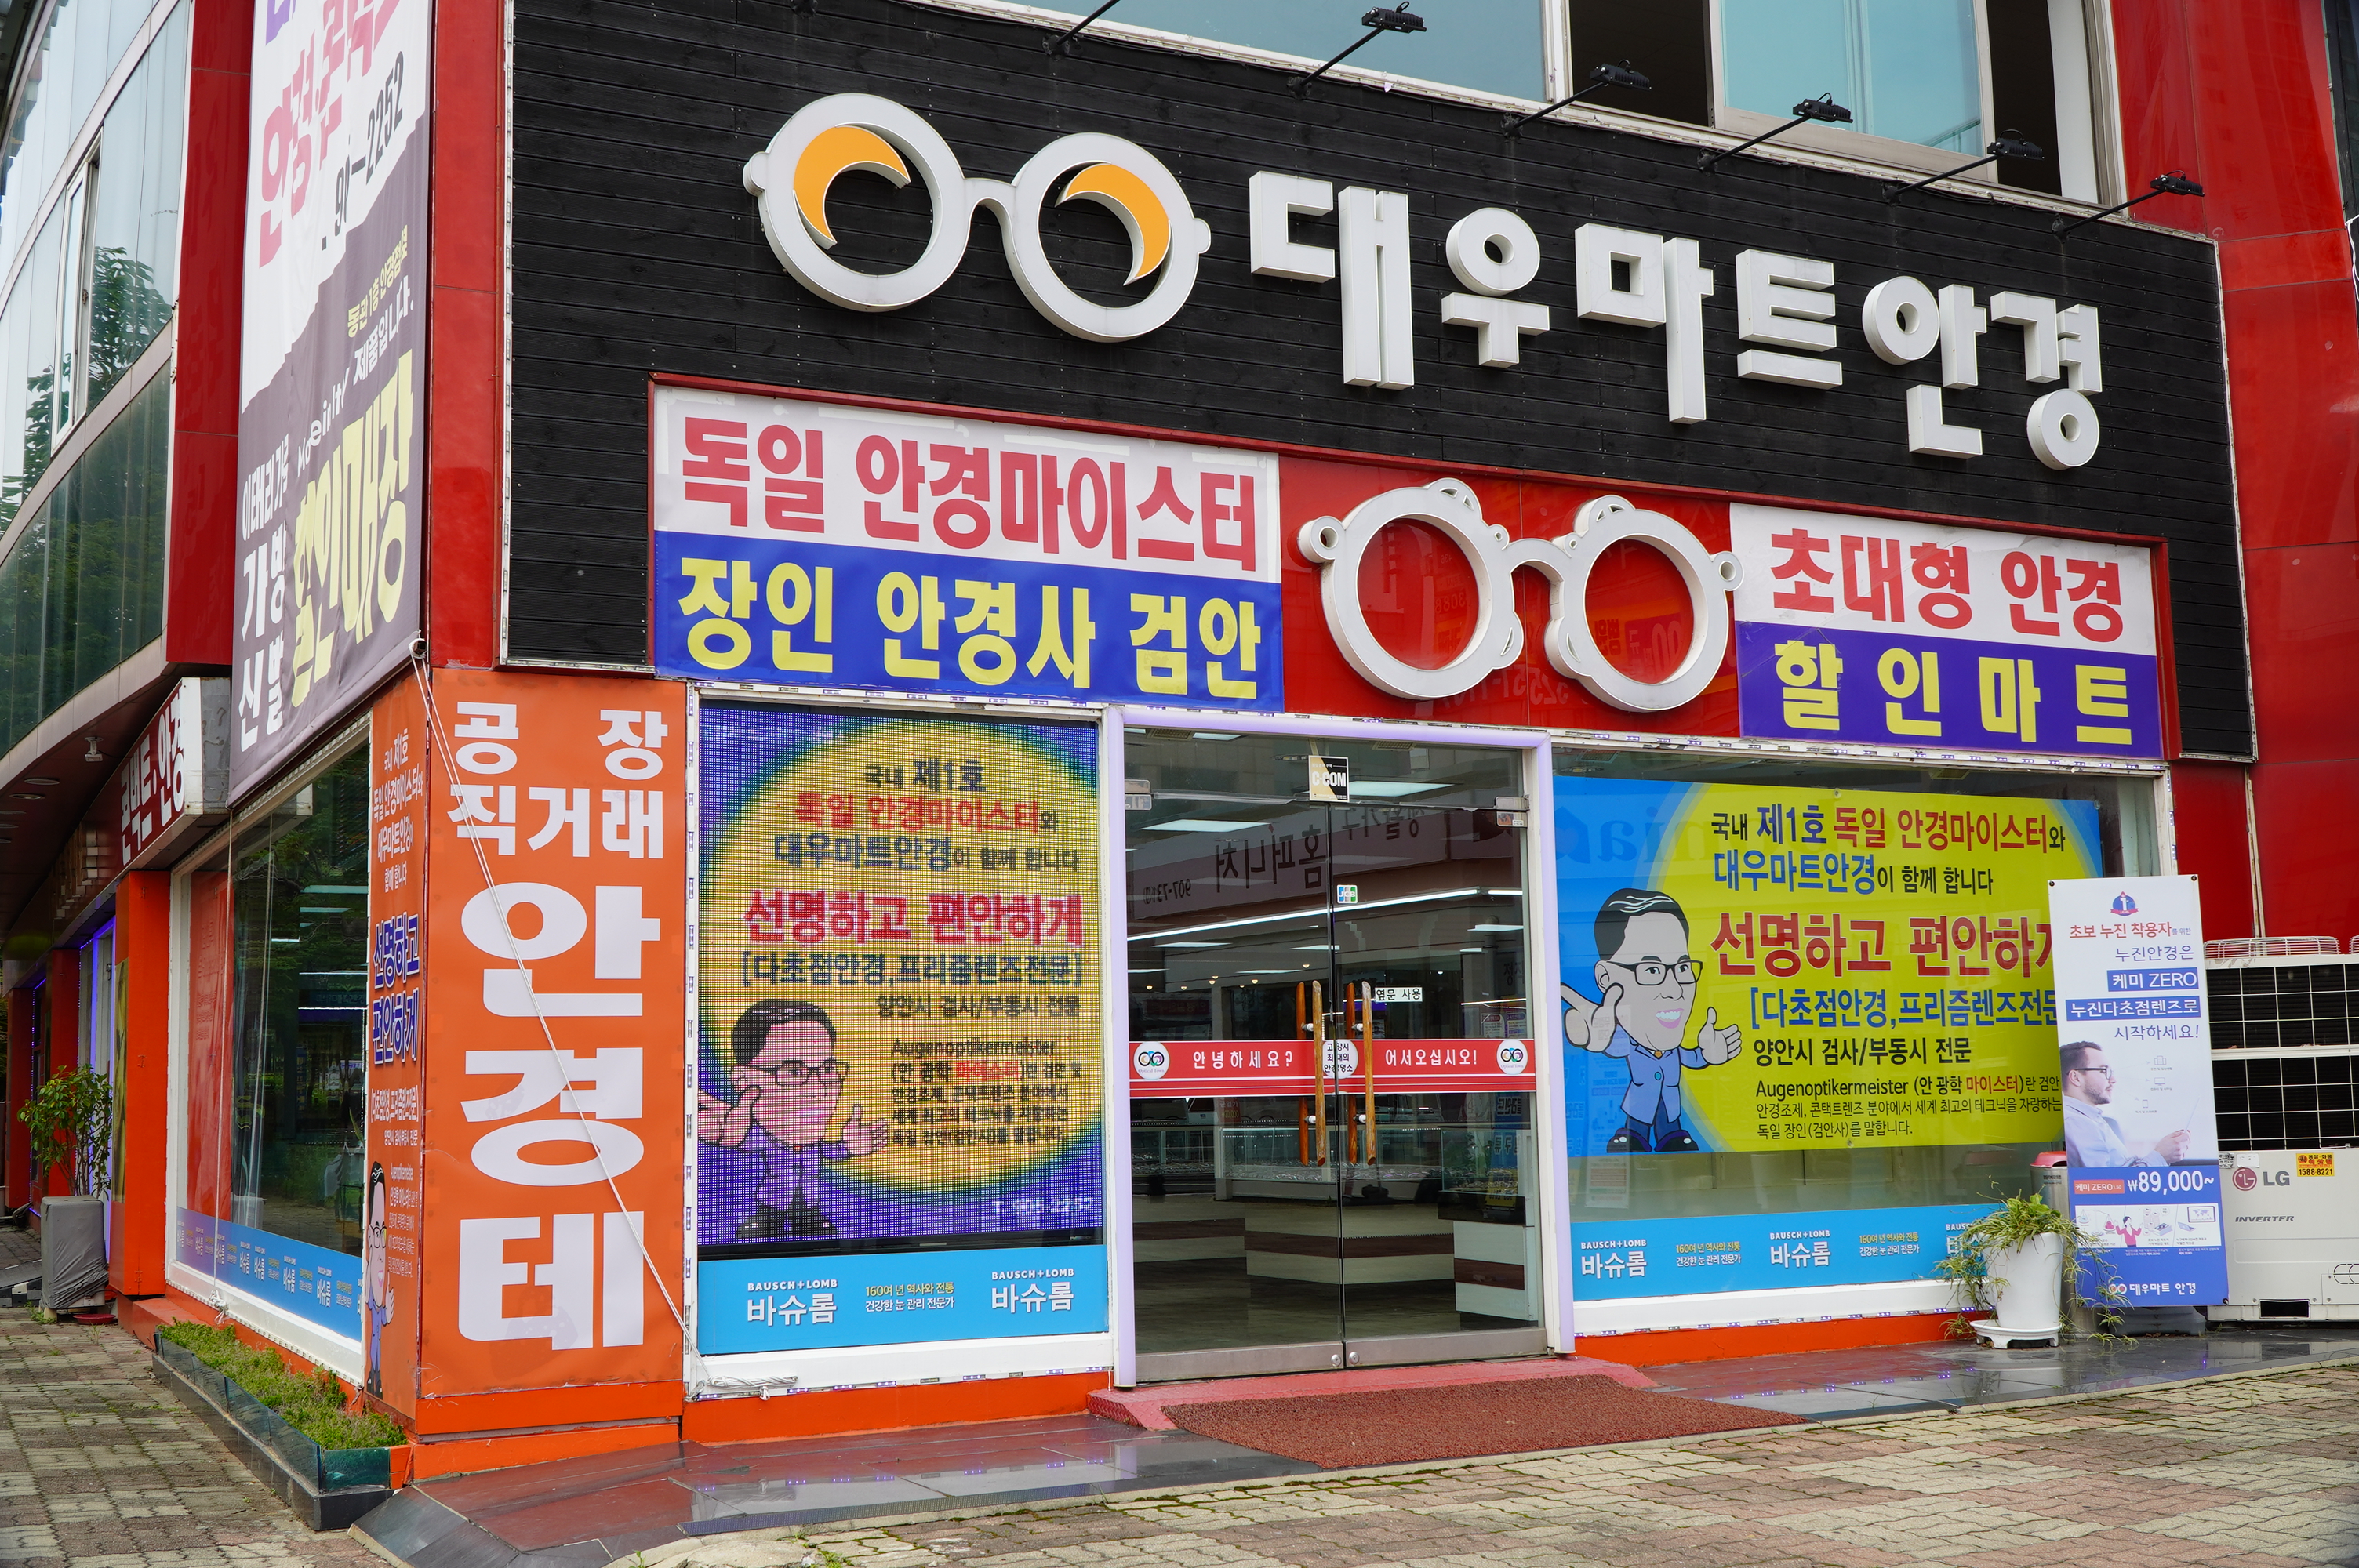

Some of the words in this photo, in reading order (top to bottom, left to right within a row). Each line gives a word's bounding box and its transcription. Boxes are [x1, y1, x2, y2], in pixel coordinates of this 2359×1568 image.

[1249, 170, 2103, 470] 대우마트안경
[682, 416, 824, 533] 독일
[856, 434, 1256, 572] 안경마이스터
[242, 521, 286, 641] 가방
[1769, 528, 1973, 630] 초대형
[2001, 550, 2125, 644] 안경
[678, 557, 834, 673] 장인
[876, 570, 1096, 688] 안경사
[1129, 593, 1261, 700] 검안
[239, 630, 284, 752] 신발
[1775, 638, 2132, 747] 할인마트
[864, 764, 903, 789] 국내
[912, 758, 987, 792] 제1호
[1312, 771, 1347, 787] C-COM
[447, 783, 664, 859] 직거래
[795, 793, 853, 829] 독일
[868, 793, 1059, 833] 안경마이스터와
[1711, 812, 1748, 841] 국내
[1757, 804, 1827, 844] 제1호
[1834, 807, 1886, 848] 독일
[1898, 809, 2065, 853] 안경마이스터와
[774, 833, 970, 872] 대우마트안경이
[980, 847, 1016, 871] 함께
[1025, 848, 1079, 872] 합니다
[1714, 849, 1893, 895] 대우마트안경이
[1901, 866, 1937, 894] 함께
[1943, 866, 1994, 895] 합니다
[743, 890, 911, 946] 선명하고
[927, 893, 1084, 946] 편안하게
[2070, 925, 2096, 938] 초보
[2100, 923, 2127, 939] 누진
[373, 912, 420, 989] 선명하고
[1710, 912, 1892, 978] 선명하고
[2115, 945, 2194, 962] 누진안경은
[2113, 973, 2143, 989] 케미
[2149, 972, 2197, 987] ZERO
[877, 995, 931, 1018] 양안시
[1048, 993, 1081, 1018] 전문
[1402, 988, 1420, 1000] 사용
[2071, 1000, 2199, 1018] 누진다초점렌즈로
[373, 988, 419, 1065] 편안하게
[2114, 1025, 2199, 1041] 시작하세요!
[1193, 1048, 1293, 1069] 안녕하세요?
[1385, 1049, 1478, 1067] 어서오십시오!
[1754, 1037, 1812, 1066] 양안시
[1821, 1037, 1927, 1066] 검사/부동시
[1936, 1037, 1971, 1064] 전문
[1756, 1078, 1908, 1102] Augenoptikermeister
[1914, 1076, 1934, 1096] (안
[1936, 1076, 1962, 1095] 광학
[2039, 1076, 2060, 1092] 검안
[459, 881, 662, 1351] 안경테
[1756, 1102, 1807, 1120] 안경조제,
[1810, 1101, 1863, 1119] 콘택트렌즈
[1867, 1099, 1912, 1116] 분야에서
[1915, 1098, 1937, 1115] 세계
[1940, 1098, 1972, 1114] 최고의
[1975, 1097, 2017, 1113] 테크닉을
[2019, 1096, 2062, 1112] 자랑하는
[1757, 1123, 1780, 1140] 독일
[1784, 1120, 1862, 1139] 장인(검안사)를
[1864, 1120, 1913, 1137] 말합니다.
[2075, 1184, 2090, 1192] 케미
[2263, 1171, 2291, 1187] LG
[1012, 1197, 1094, 1214] 905-2252
[1580, 1239, 1647, 1250] BAUSCH+LOMB
[1769, 1229, 1830, 1240] BAUSCH+LOMB
[1859, 1234, 1877, 1244] 160여
[1886, 1232, 1905, 1243] 역사와
[1906, 1232, 1919, 1242] 전통
[1676, 1243, 1696, 1254] 160여
[1698, 1243, 1704, 1253] 년
[1705, 1242, 1726, 1252] 역사와
[1727, 1240, 1741, 1251] 전통
[1770, 1241, 1831, 1269] 바슈롬
[1859, 1247, 1878, 1257] 건강한
[1887, 1245, 1899, 1255] 관리
[1900, 1243, 1921, 1254] 전문가
[1581, 1250, 1648, 1279] 바슈롬
[1676, 1256, 1697, 1267] 건강한
[1706, 1254, 1720, 1265] 관리
[1721, 1254, 1741, 1265] 전문가
[747, 1279, 838, 1292] BAUSCH+LOMB
[991, 1268, 1074, 1281] BAUSCH+LOMB
[865, 1284, 893, 1298] 160여
[894, 1283, 905, 1296] 년
[906, 1283, 934, 1295] 역사와
[936, 1281, 955, 1294] 전통
[991, 1281, 1074, 1314] 바슈롬
[2129, 1283, 2170, 1295] 대우마트
[2175, 1283, 2196, 1295] 안경
[747, 1293, 838, 1327] 바슈롬
[865, 1300, 893, 1313] 건강한
[895, 1299, 905, 1311] 눈
[906, 1298, 925, 1311] 관리
[926, 1297, 955, 1309] 전문가
